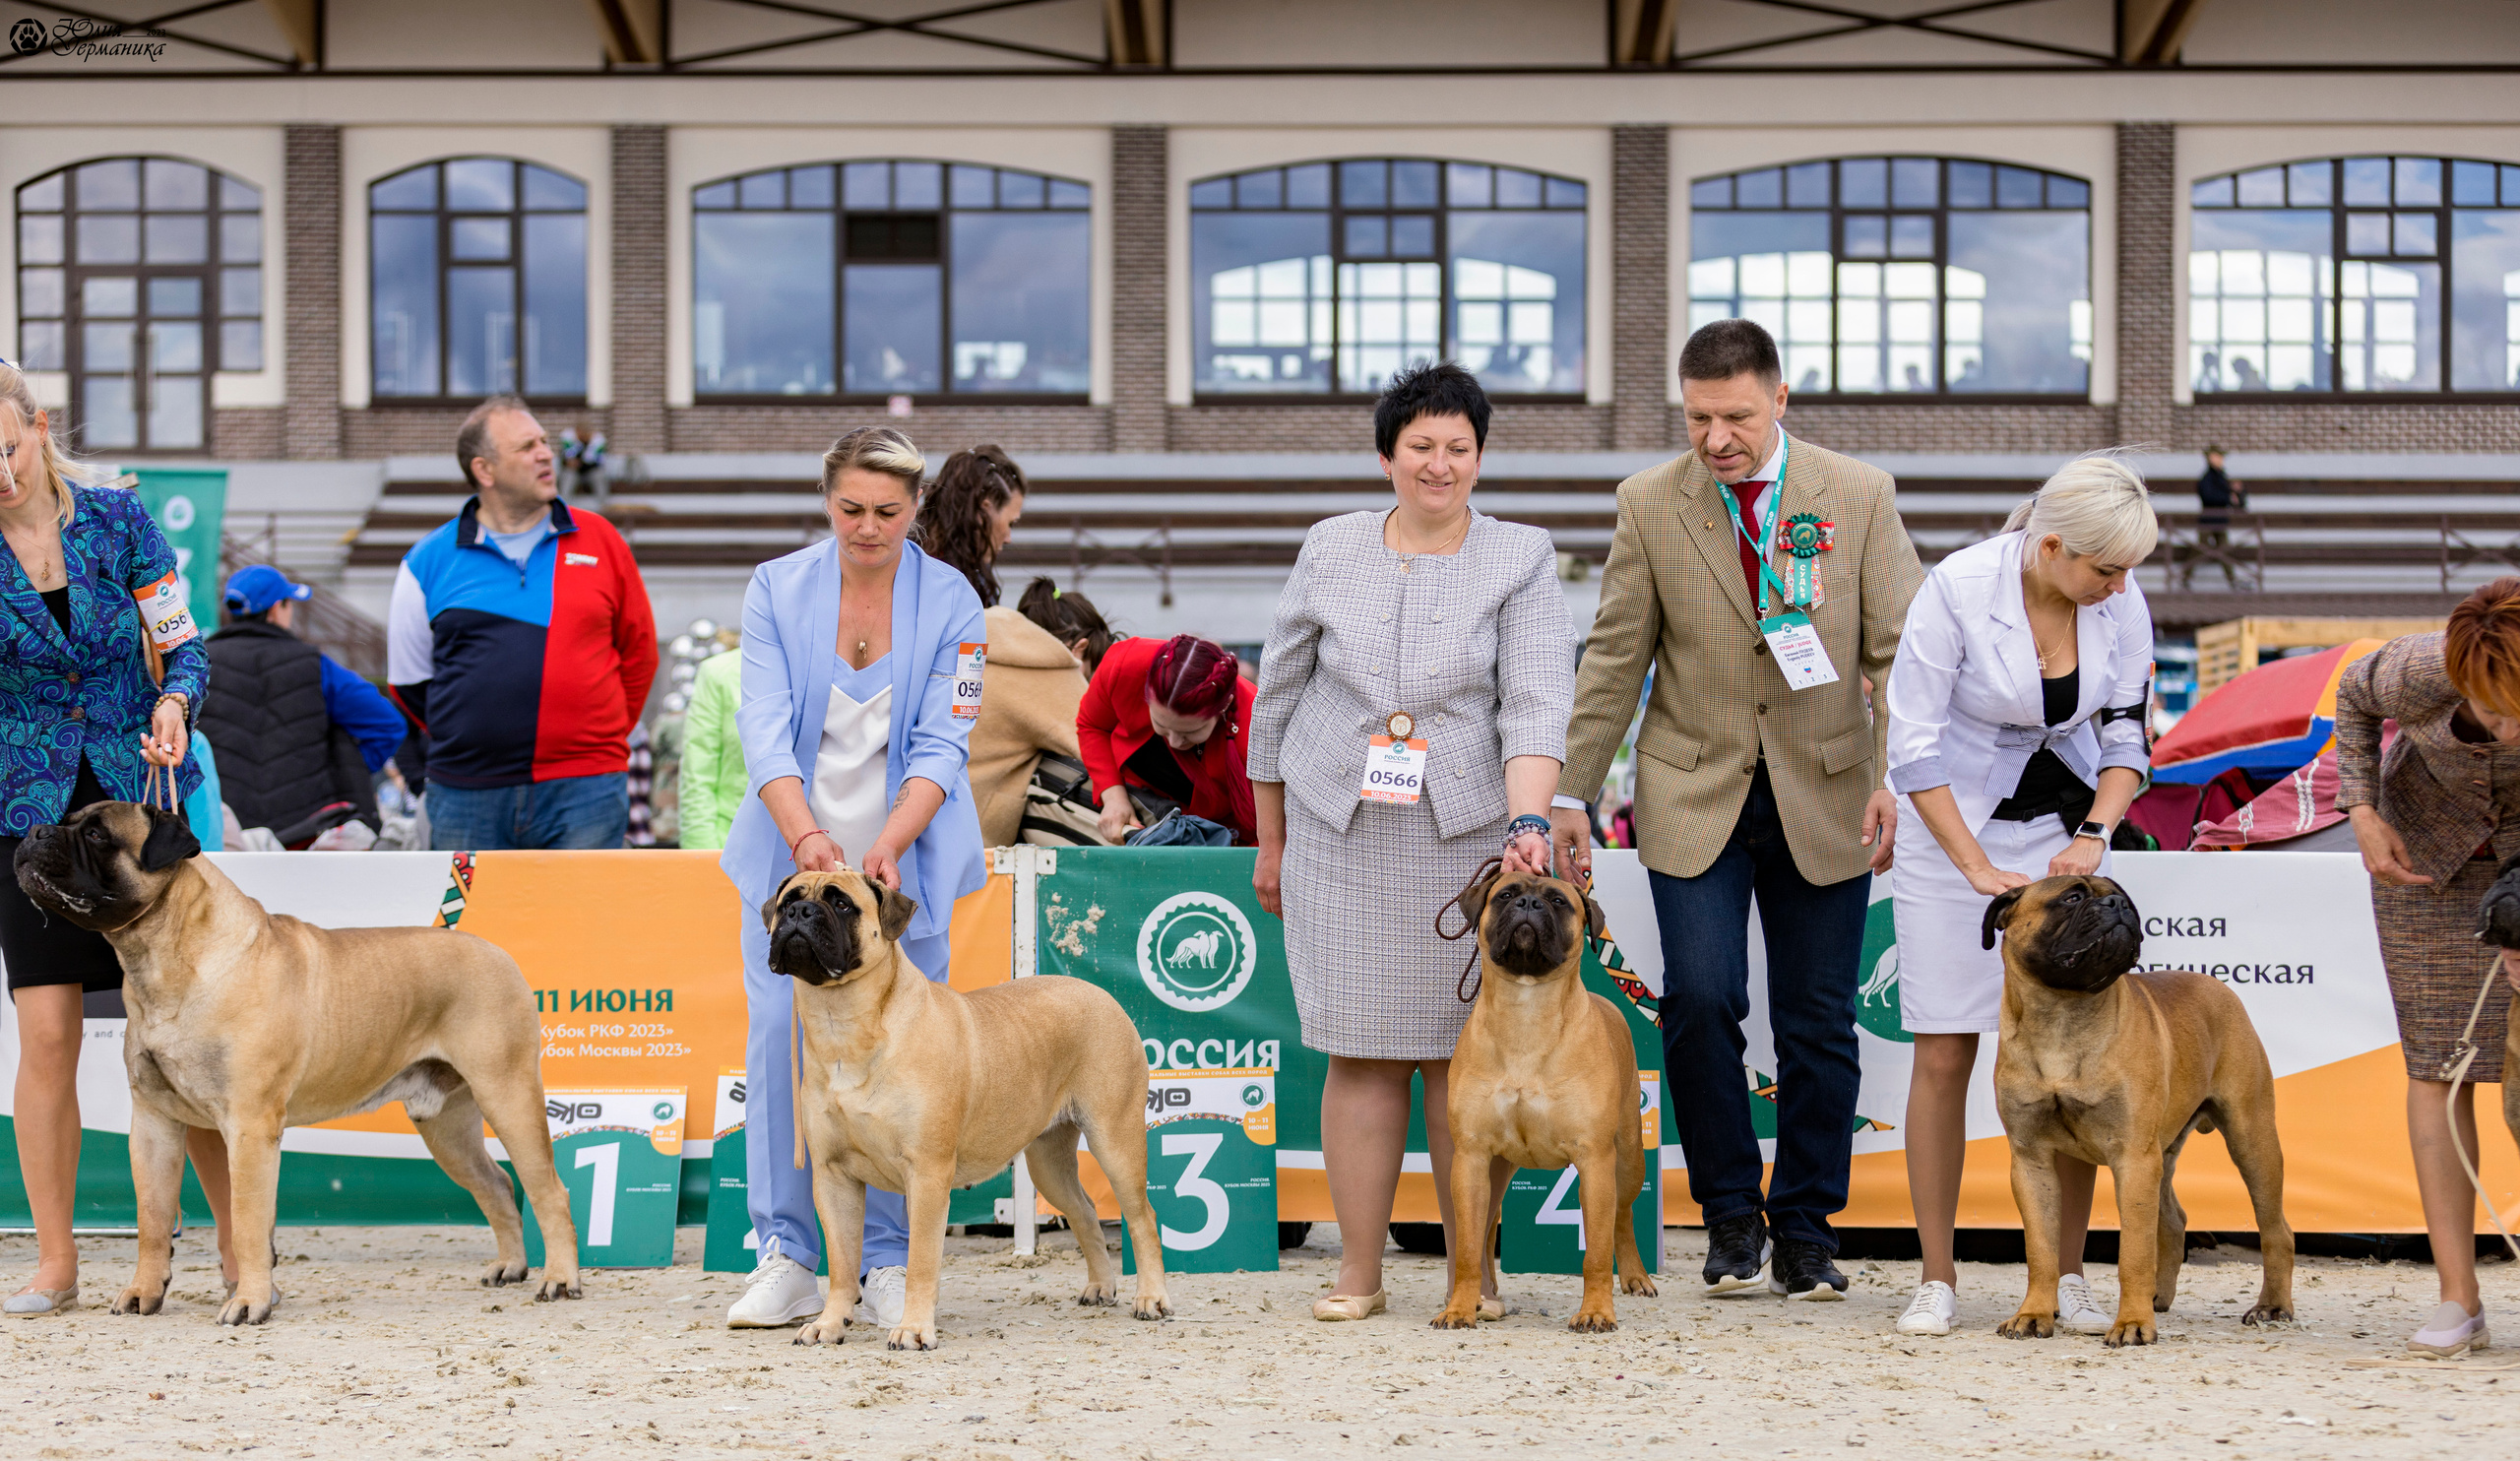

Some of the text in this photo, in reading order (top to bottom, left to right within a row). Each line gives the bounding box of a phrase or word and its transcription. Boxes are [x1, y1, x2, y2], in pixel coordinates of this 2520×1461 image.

[1719, 483, 1731, 499] РКФ
[1765, 511, 1775, 527] РКФ
[157, 610, 190, 634] 056
[1369, 770, 1418, 788] 0566
[1370, 791, 1412, 801] 10.06.2023
[534, 988, 673, 1013] 11 ИЮНЯ
[590, 1024, 625, 1038] РКФ
[628, 1024, 674, 1038] 2023»
[579, 1044, 642, 1057] Москвы
[646, 1043, 692, 1056] 2023»
[1142, 1038, 1280, 1072] ОССИЯ
[574, 1142, 620, 1246] 1
[1162, 1133, 1229, 1251] 3
[1536, 1163, 1586, 1250] 4
